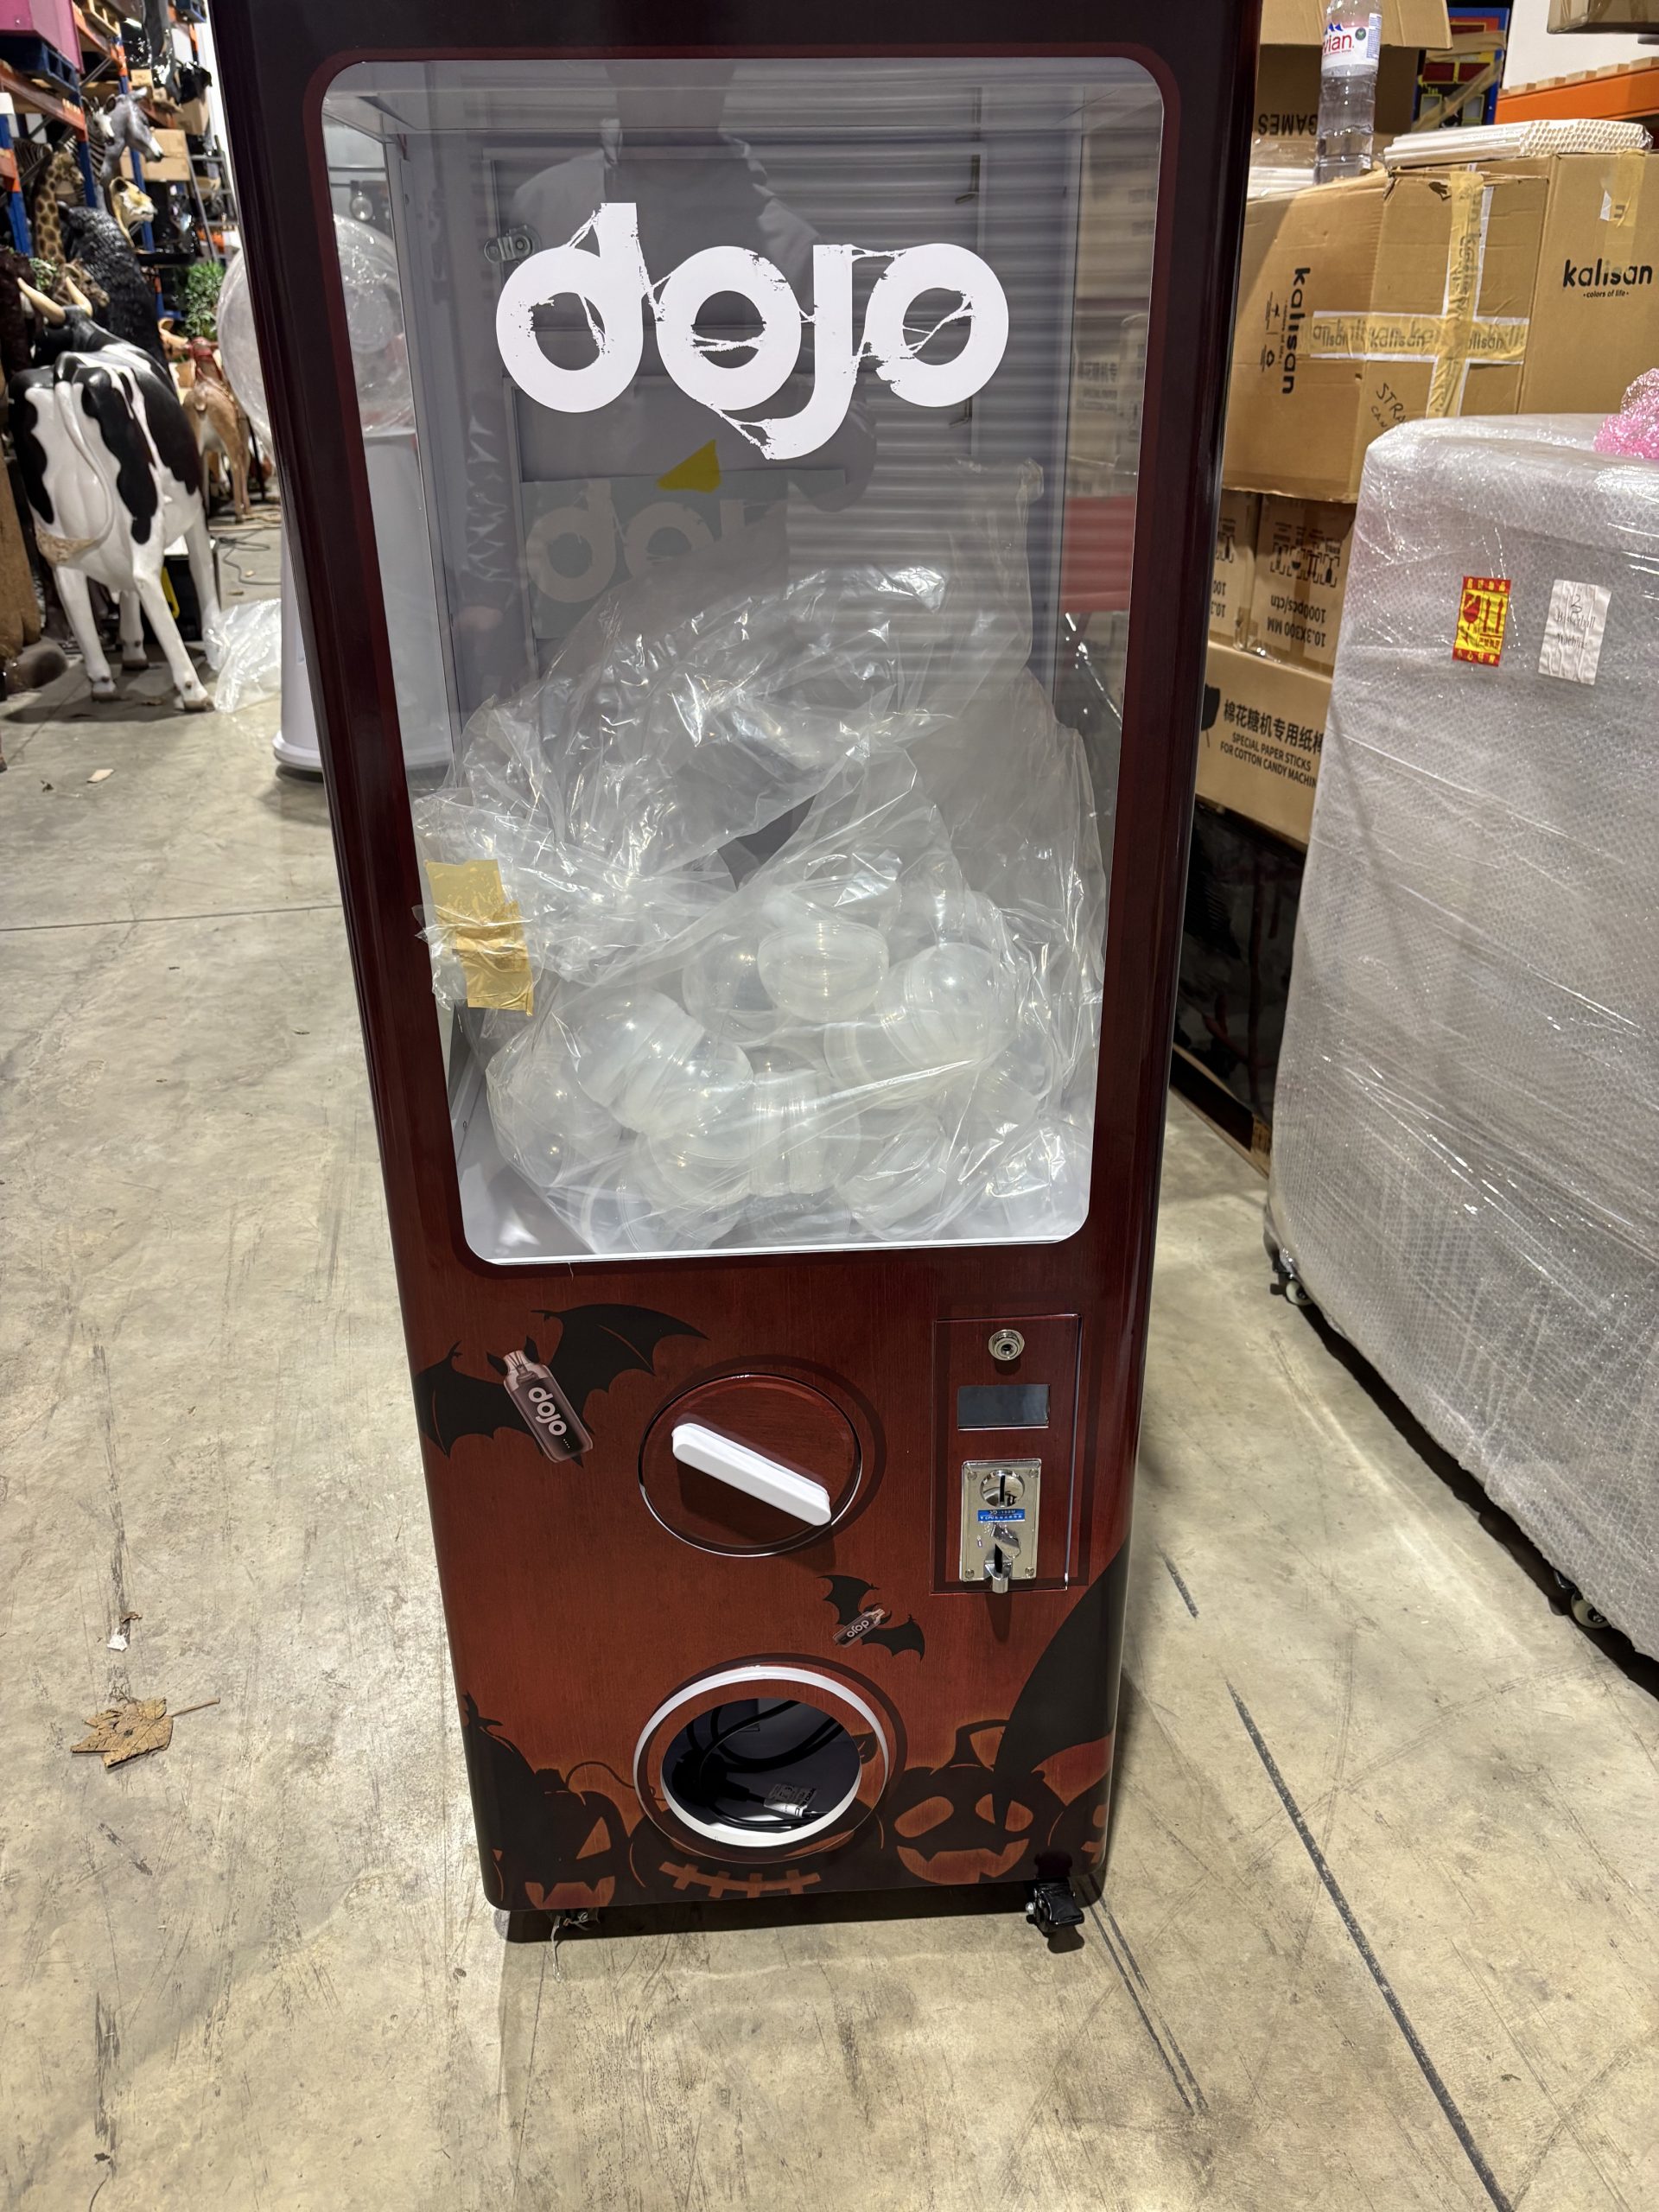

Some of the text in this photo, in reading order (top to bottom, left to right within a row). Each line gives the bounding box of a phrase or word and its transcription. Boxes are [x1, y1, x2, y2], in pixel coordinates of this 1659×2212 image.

[1323, 34, 1352, 54] vian
[1258, 113, 1319, 137] GAMES
[1562, 257, 1652, 288] kalisan
[496, 202, 1009, 460] dojo
[1282, 267, 1311, 394] kalisan
[1270, 594, 1326, 625] 1000pcs/ctn
[1267, 616, 1283, 635] MM
[1220, 741, 1317, 788] FOR COTTON CANDY MACHIN
[1232, 732, 1312, 772] SPECIAL PAPER STICKS
[528, 1386, 568, 1436] dojo
[846, 1619, 870, 1638] dojo
